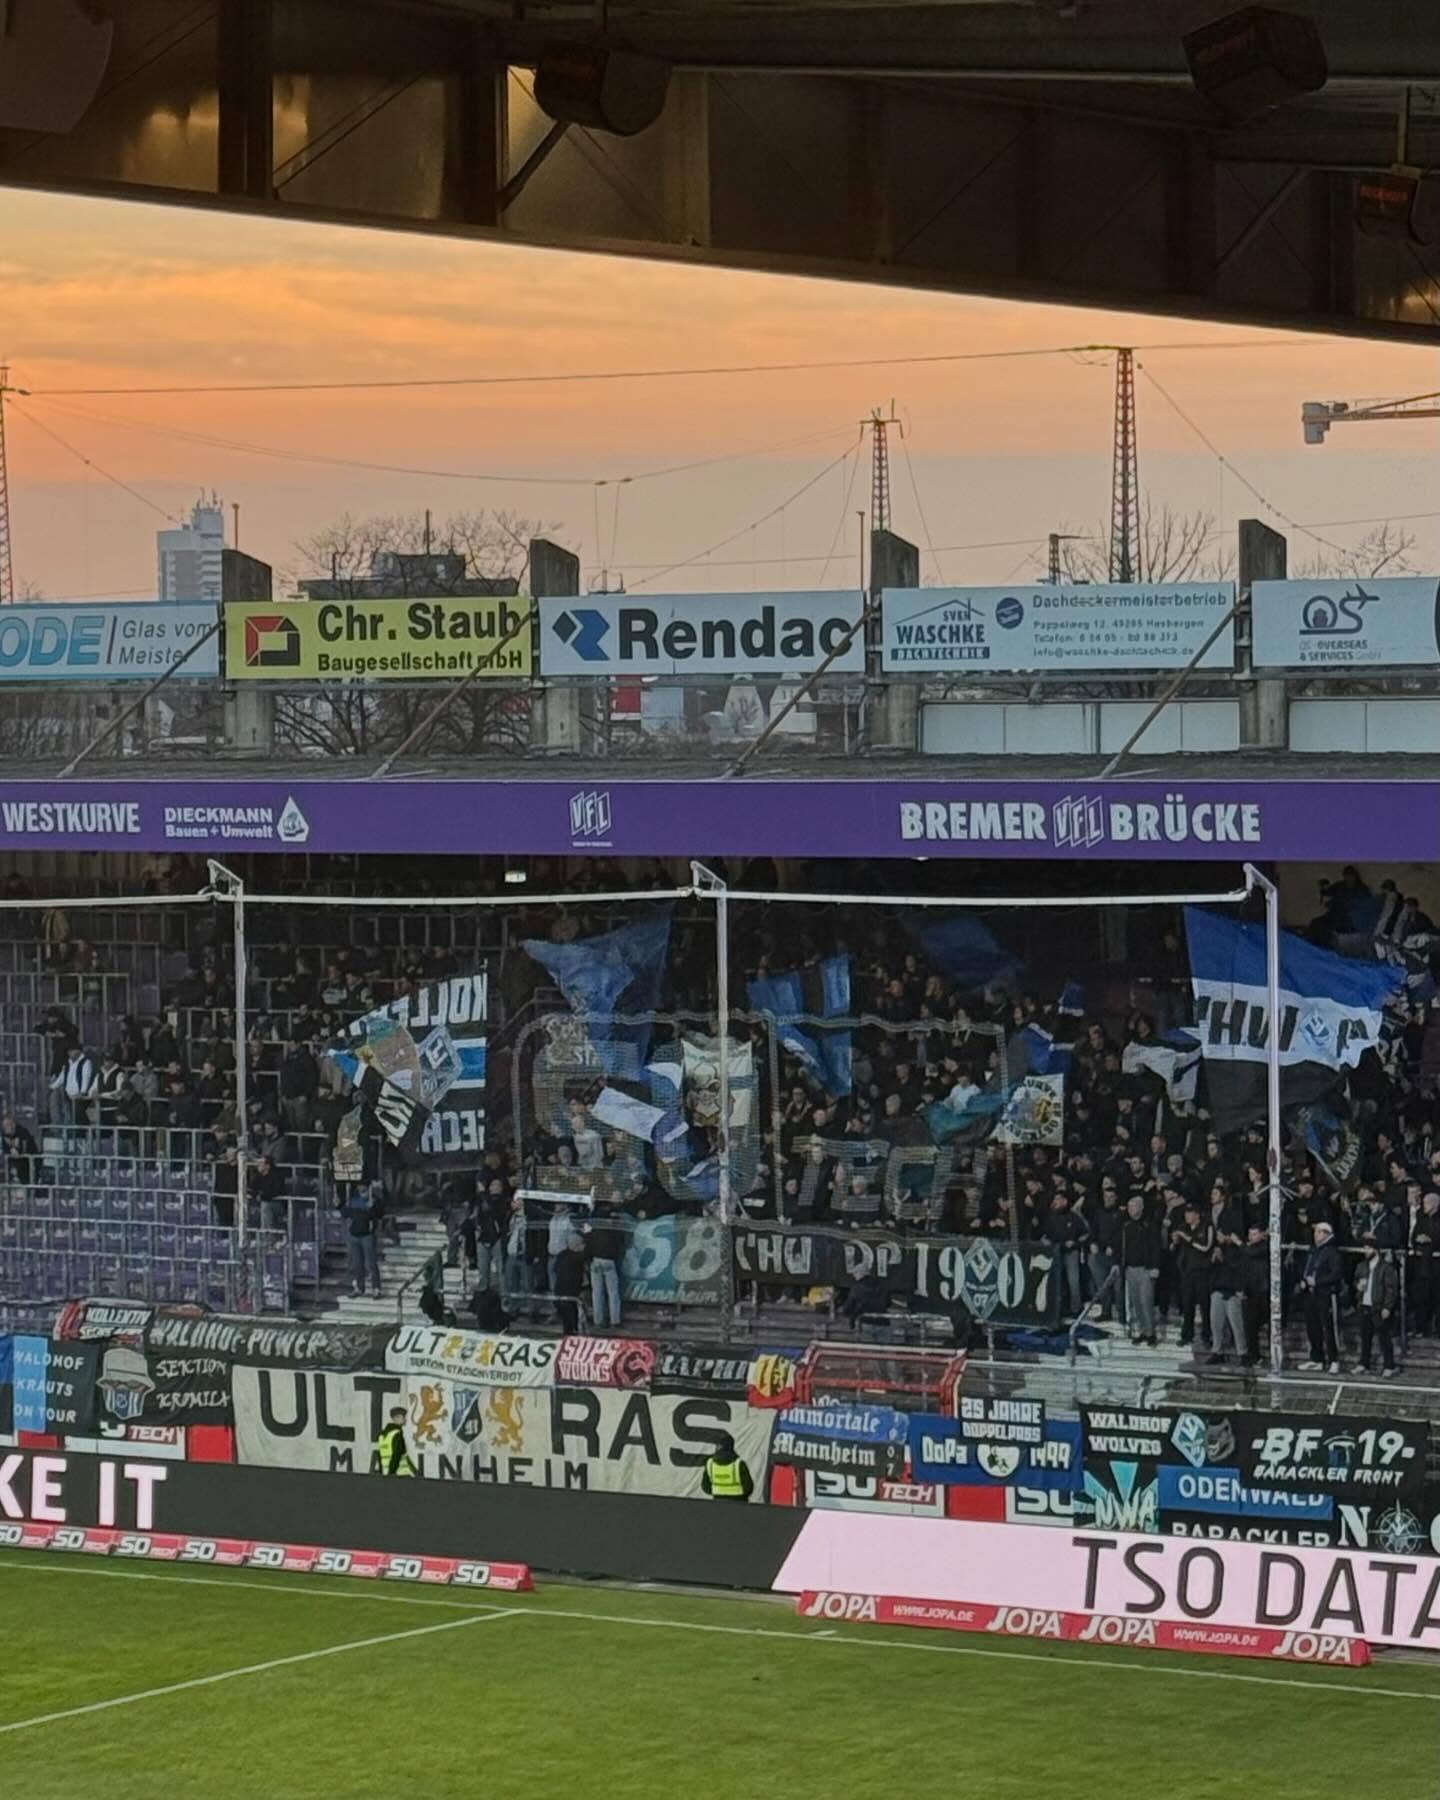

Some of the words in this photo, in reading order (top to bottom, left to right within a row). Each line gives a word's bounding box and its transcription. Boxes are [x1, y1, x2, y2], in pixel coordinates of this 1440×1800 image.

[122, 620, 166, 638] Glas
[174, 622, 212, 638] vom
[318, 604, 397, 641] Chr.
[408, 602, 521, 640] Staub
[618, 606, 853, 660] Rendac
[896, 624, 985, 645] WASCHKE
[1317, 640, 1368, 650] OVERSEAS
[317, 651, 473, 675] Baugesellschaft
[1309, 651, 1354, 662] SERVICES
[2, 802, 141, 833] WESTKURVE
[164, 807, 273, 823] DIECKMANN
[900, 802, 1047, 840] BREMER
[1110, 794, 1261, 842] BRÜCKE
[165, 825, 208, 838] Bauen
[221, 825, 273, 838] Umwelt
[85, 1306, 152, 1325] KOLLEKTIV
[13, 1349, 85, 1371] WALDHOF
[155, 1358, 228, 1379] SEKTION
[15, 1380, 75, 1398] KRAUTS
[14, 1404, 33, 1417] ON
[38, 1407, 77, 1424] TOUR
[1087, 1411, 1171, 1434] WALDHOF
[130, 1425, 175, 1443] TECH
[771, 1431, 877, 1467] Mannheim
[921, 1435, 969, 1465] DoPa
[1088, 1435, 1162, 1456] WOLVES
[1252, 1464, 1349, 1483] BARACKLER
[1353, 1469, 1404, 1487] FRONT
[99, 1461, 167, 1530] IT
[882, 1482, 933, 1503] TECH
[1072, 1536, 1226, 1619] TSO
[805, 1592, 877, 1620] JOPA
[893, 1604, 975, 1623] WWW.JOPA.DE
[986, 1607, 1061, 1636] JOPA
[1078, 1615, 1157, 1645] JOPA
[1172, 1628, 1260, 1647] WWW.JOPA.DE
[1272, 1631, 1352, 1664] JOPA
